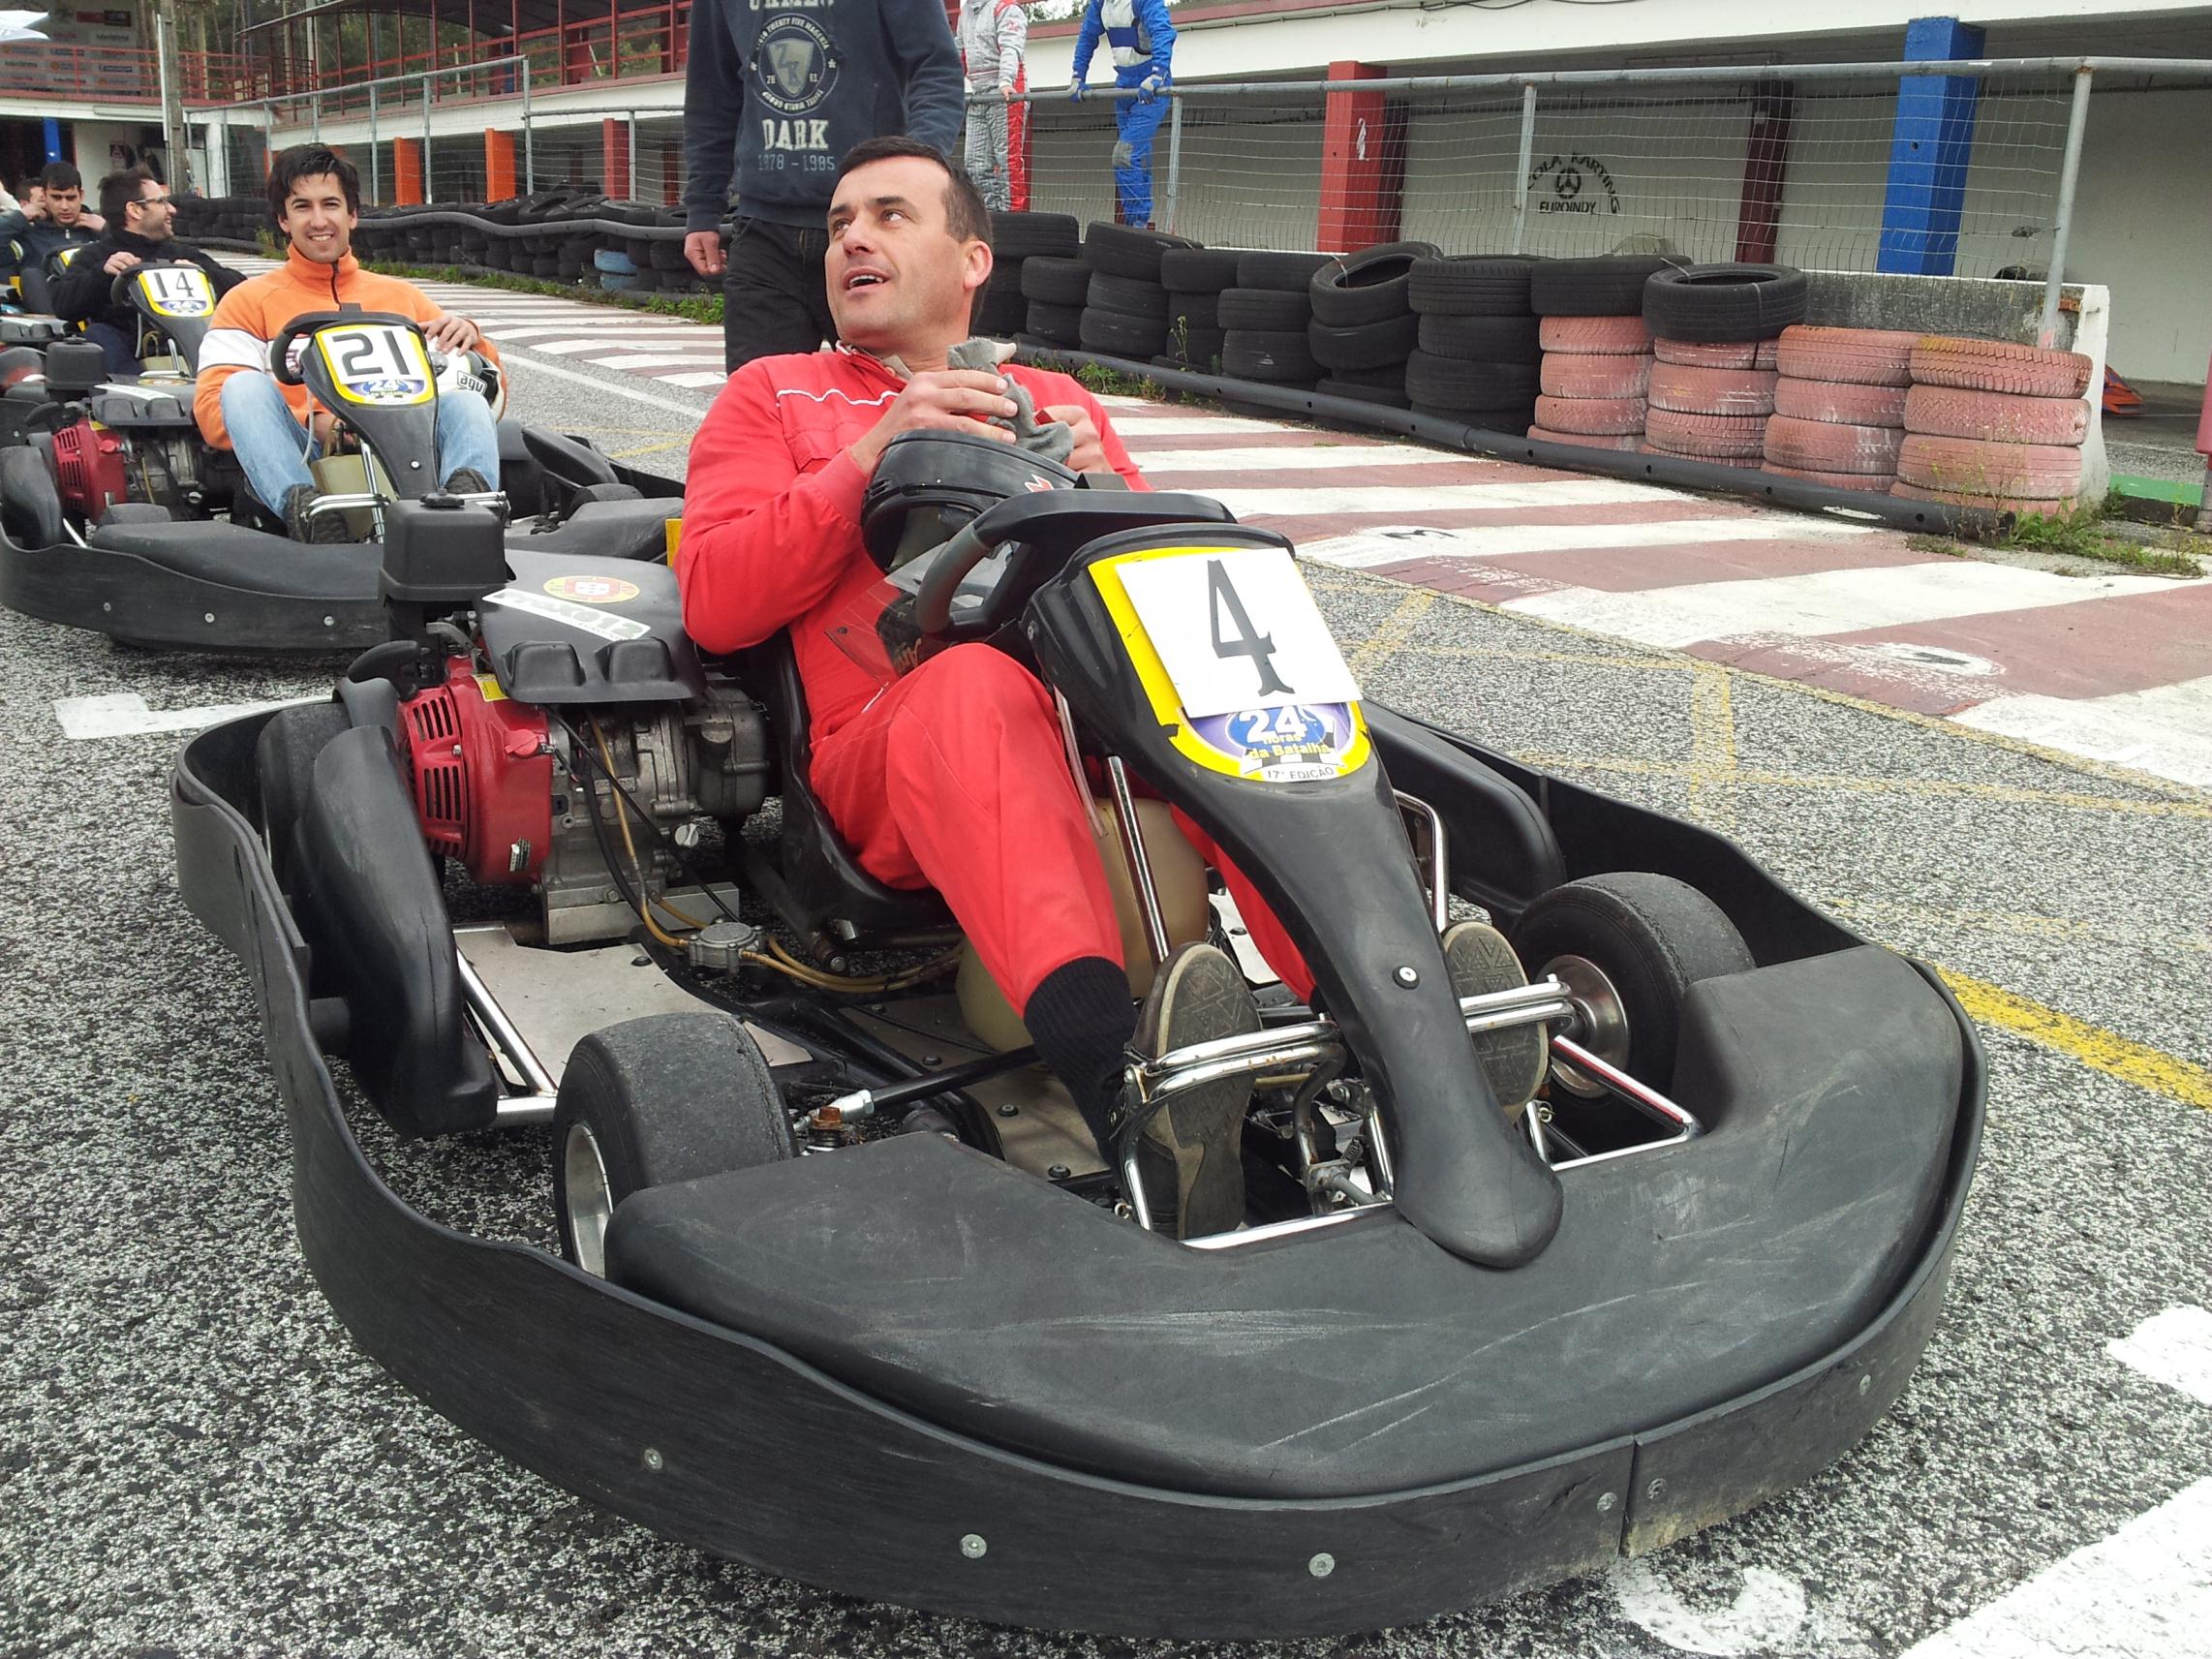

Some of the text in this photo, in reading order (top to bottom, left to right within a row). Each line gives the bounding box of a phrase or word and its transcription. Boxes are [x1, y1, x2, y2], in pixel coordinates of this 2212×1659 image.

[762, 119, 829, 151] DARK
[758, 154, 784, 170] 1978
[803, 155, 836, 171] 1985
[1571, 151, 1621, 214] KARTING
[1539, 200, 1597, 215] EUROINDY
[153, 271, 195, 298] 14
[331, 329, 412, 377] 21
[460, 375, 484, 392] agv
[1207, 559, 1296, 697] 4
[1239, 705, 1308, 744] 24
[1272, 742, 1332, 757] Batalha
